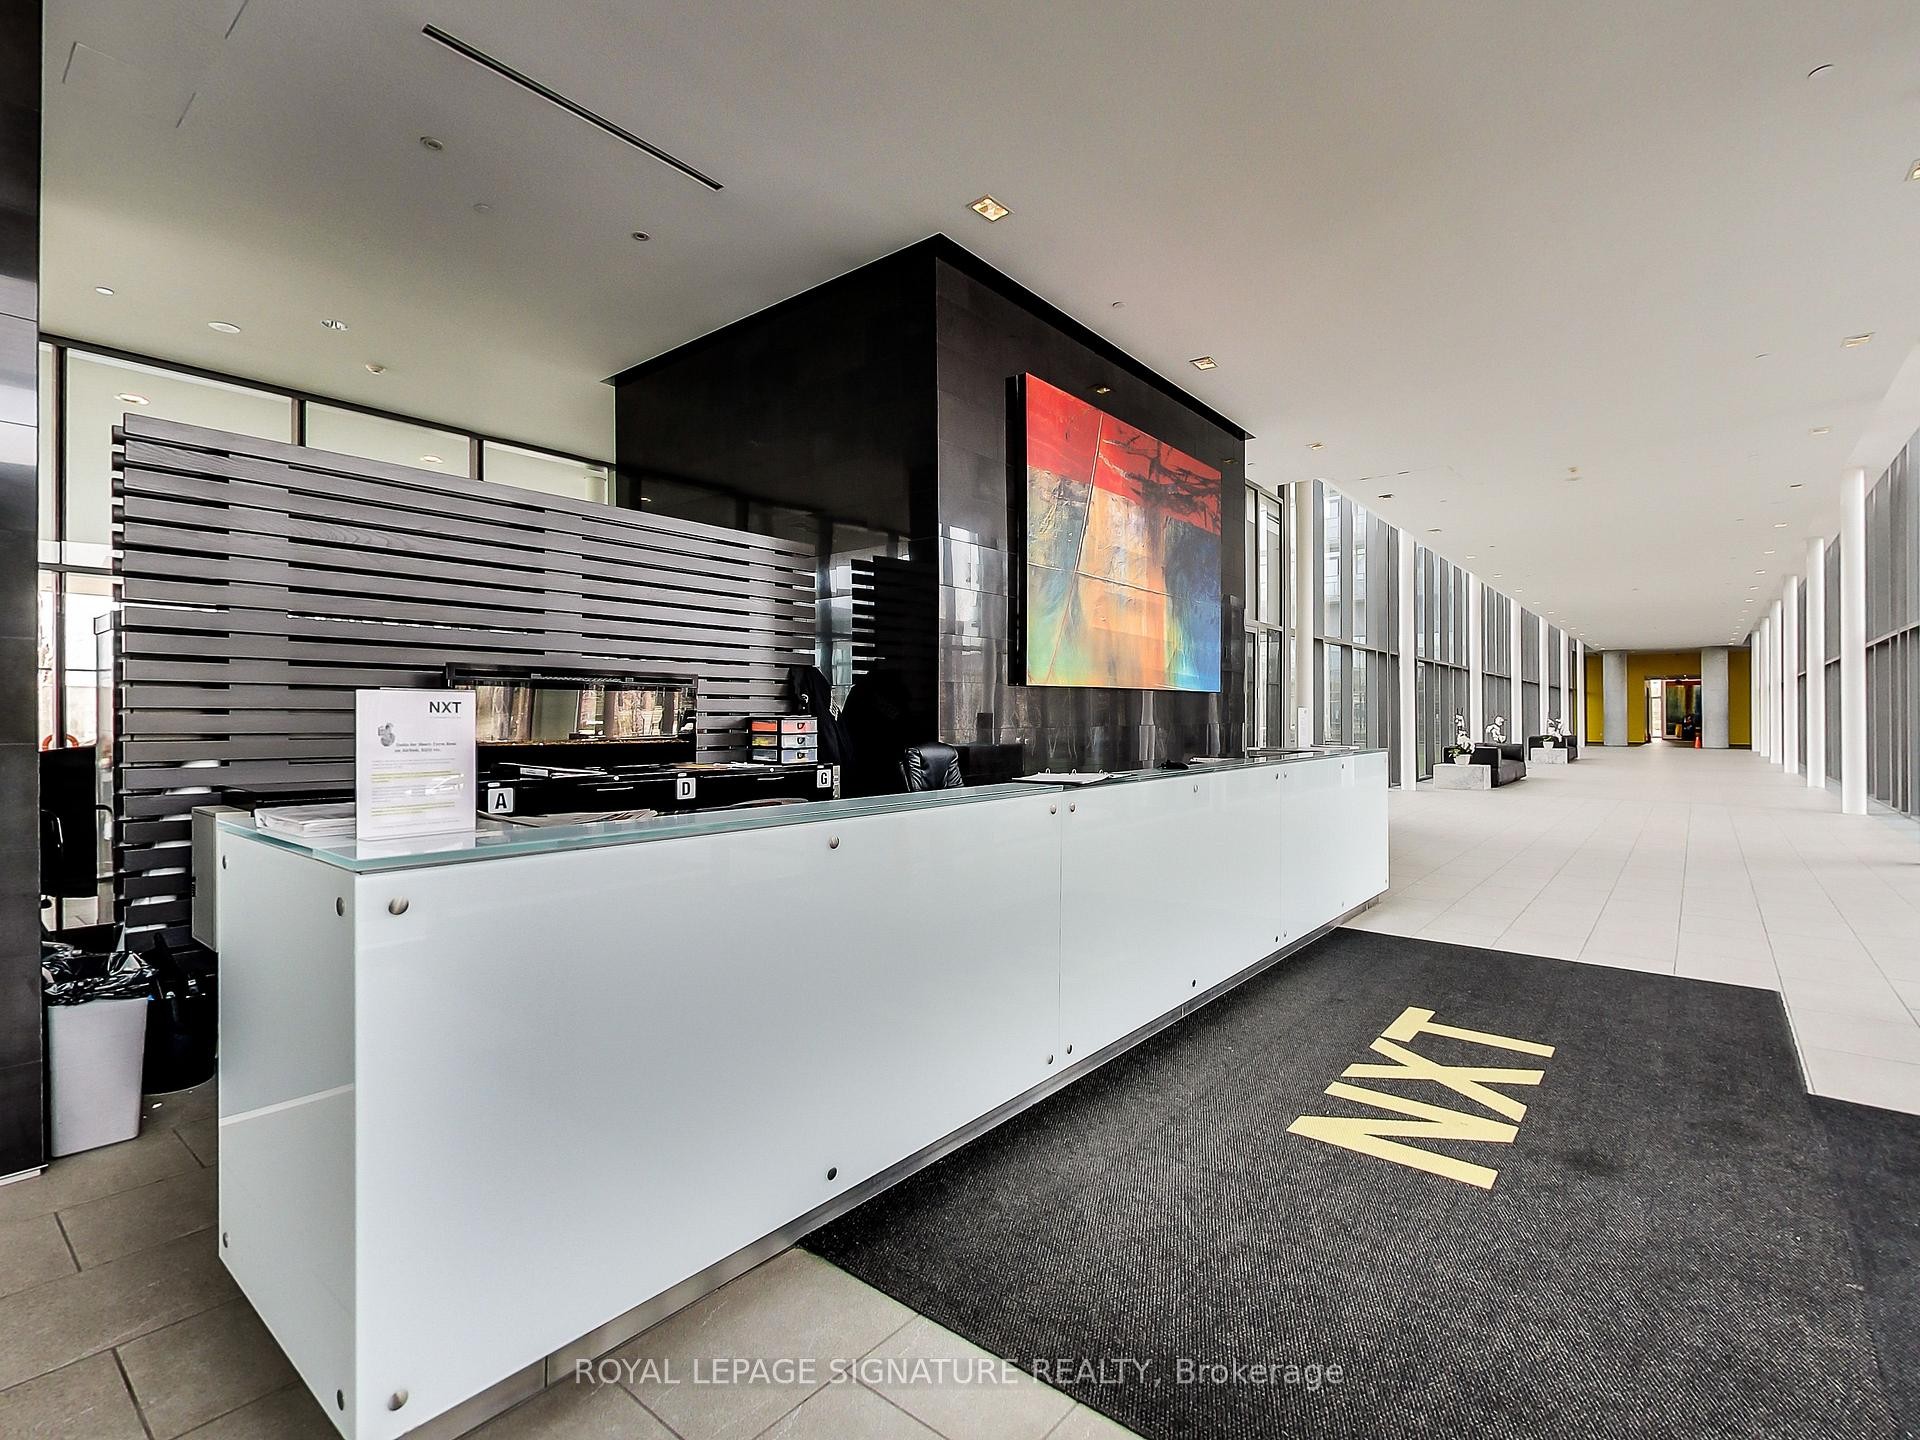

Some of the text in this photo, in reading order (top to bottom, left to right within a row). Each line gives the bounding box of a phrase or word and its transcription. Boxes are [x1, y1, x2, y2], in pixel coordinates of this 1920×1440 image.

[429, 701, 462, 714] NXT
[820, 772, 828, 785] G
[681, 781, 691, 796] D
[494, 792, 508, 810] A
[1286, 1006, 1555, 1190] NXT
